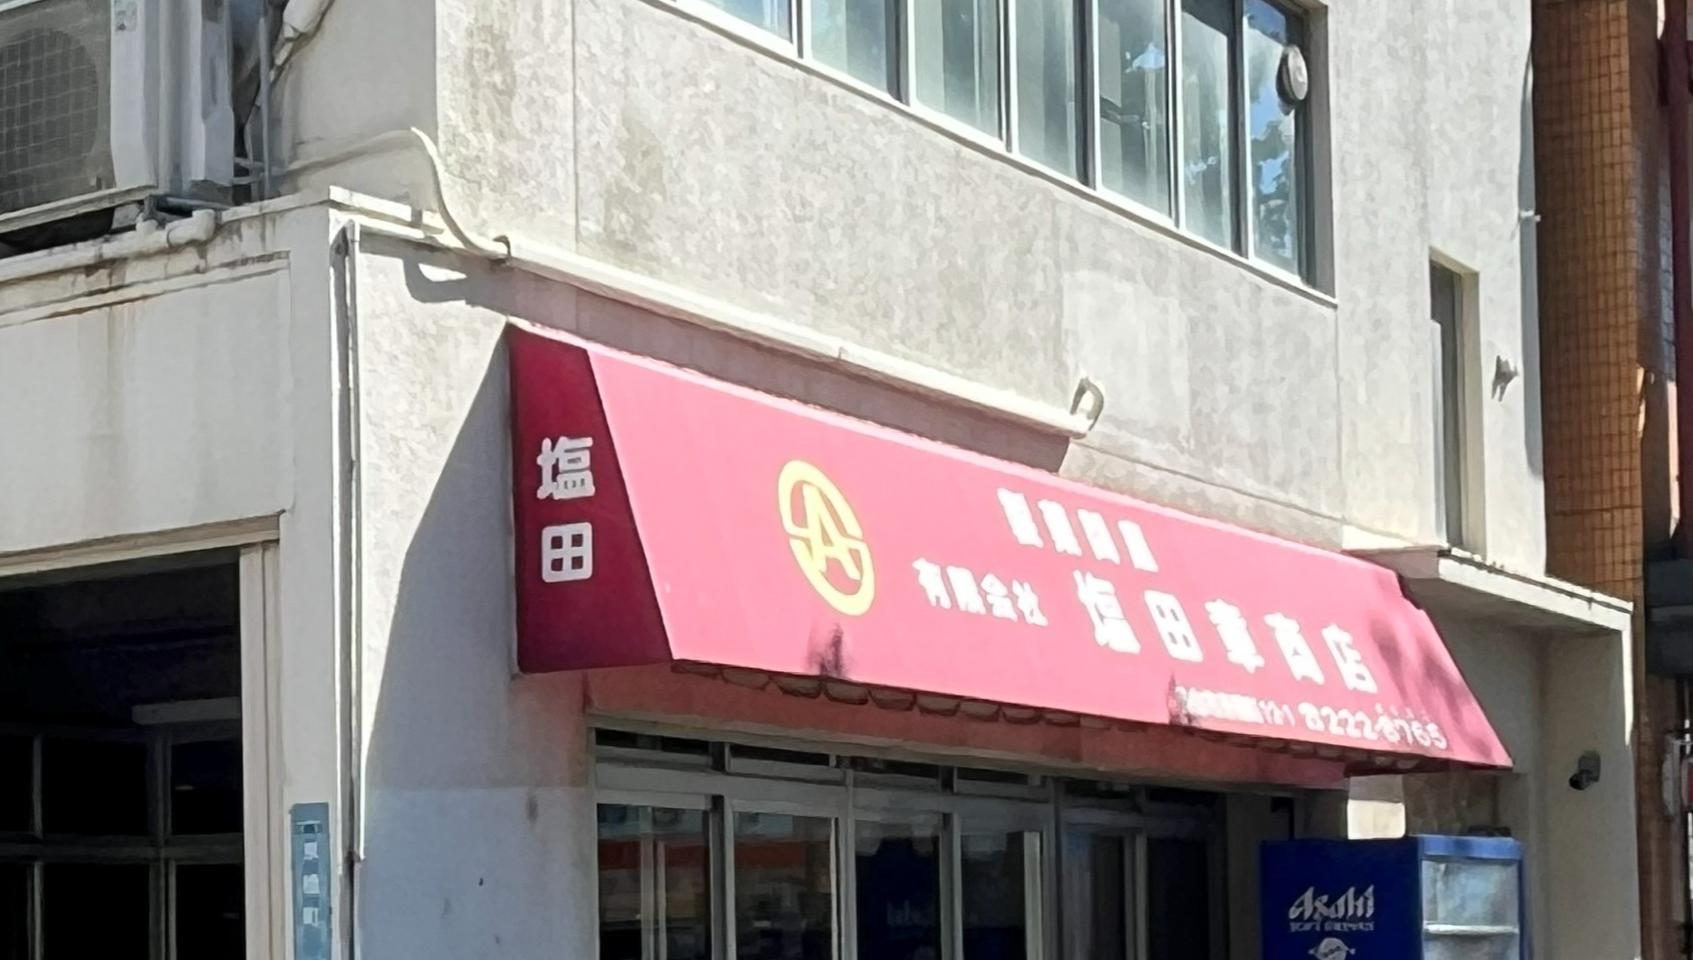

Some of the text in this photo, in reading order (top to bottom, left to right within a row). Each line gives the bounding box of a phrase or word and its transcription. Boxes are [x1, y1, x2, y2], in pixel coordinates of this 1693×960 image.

[535, 435, 596, 584] 塩田
[1072, 569, 1379, 695] 塩田章商店
[1288, 884, 1375, 920] Asahi
